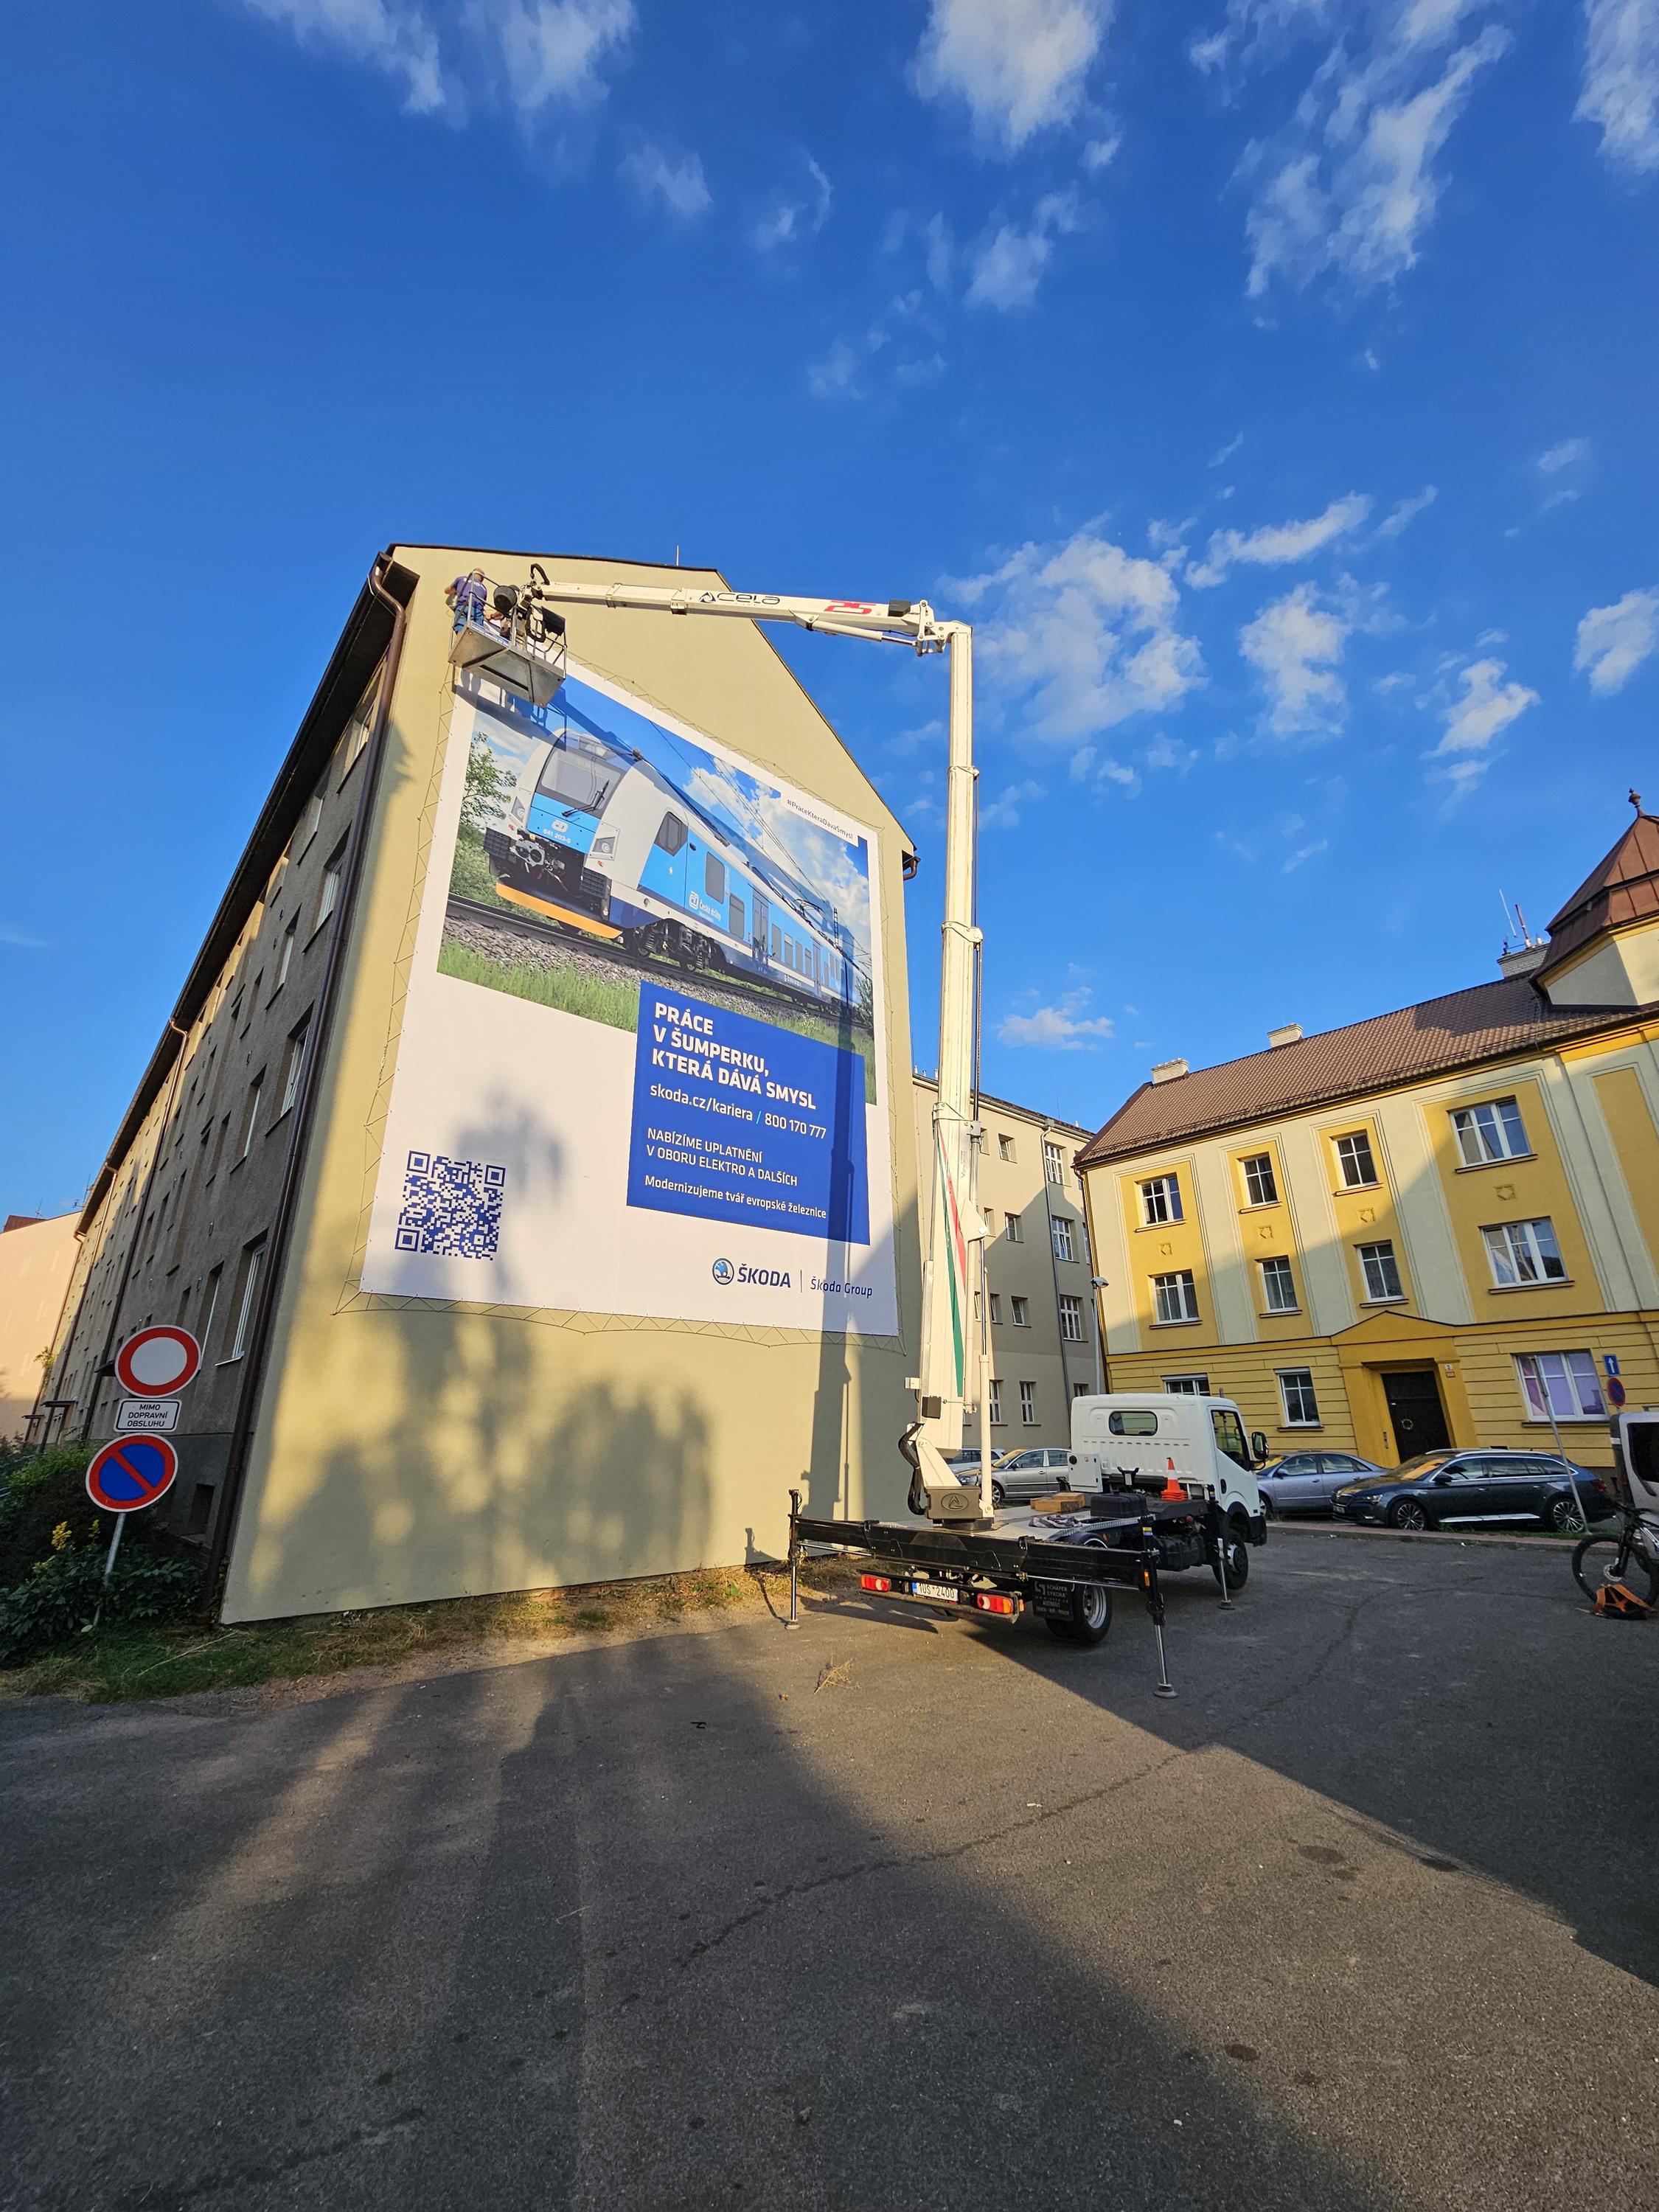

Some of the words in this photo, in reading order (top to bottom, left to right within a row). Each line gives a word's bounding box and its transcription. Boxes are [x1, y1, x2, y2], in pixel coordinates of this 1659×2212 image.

[824, 599, 876, 615] 25
[787, 799, 853, 839] #PraceKteraDavaSmysl
[655, 1002, 714, 1035] PRÁCE
[653, 1025, 667, 1043] V
[671, 1028, 769, 1077] ŠUMPERKU,
[652, 1048, 714, 1081] KTERÁ
[718, 1067, 762, 1094] DÁVÁ
[766, 1082, 816, 1110] SMYSL
[650, 1083, 753, 1121] skoda.cz/kariera
[765, 1113, 787, 1129] 800
[789, 1119, 807, 1134] 170
[809, 1124, 827, 1139] 777
[646, 1144, 655, 1156] V
[658, 1147, 696, 1166] OBORU
[699, 1155, 745, 1176] ELEKTRO
[748, 1167, 755, 1178] A
[758, 1169, 798, 1186] DALŠÍCH
[647, 1127, 702, 1150] NABÍZÍME
[705, 1141, 762, 1163] UPLATNĚNÍ
[644, 1175, 723, 1200] Modernizujeme
[726, 1191, 745, 1203] tvář
[746, 1197, 786, 1211] evropské
[788, 1203, 827, 1219] železnice
[737, 1263, 791, 1288] ŠKODA
[810, 1276, 841, 1293] Škoda
[844, 1283, 873, 1298] Group
[936, 1586, 955, 1599] 2400
